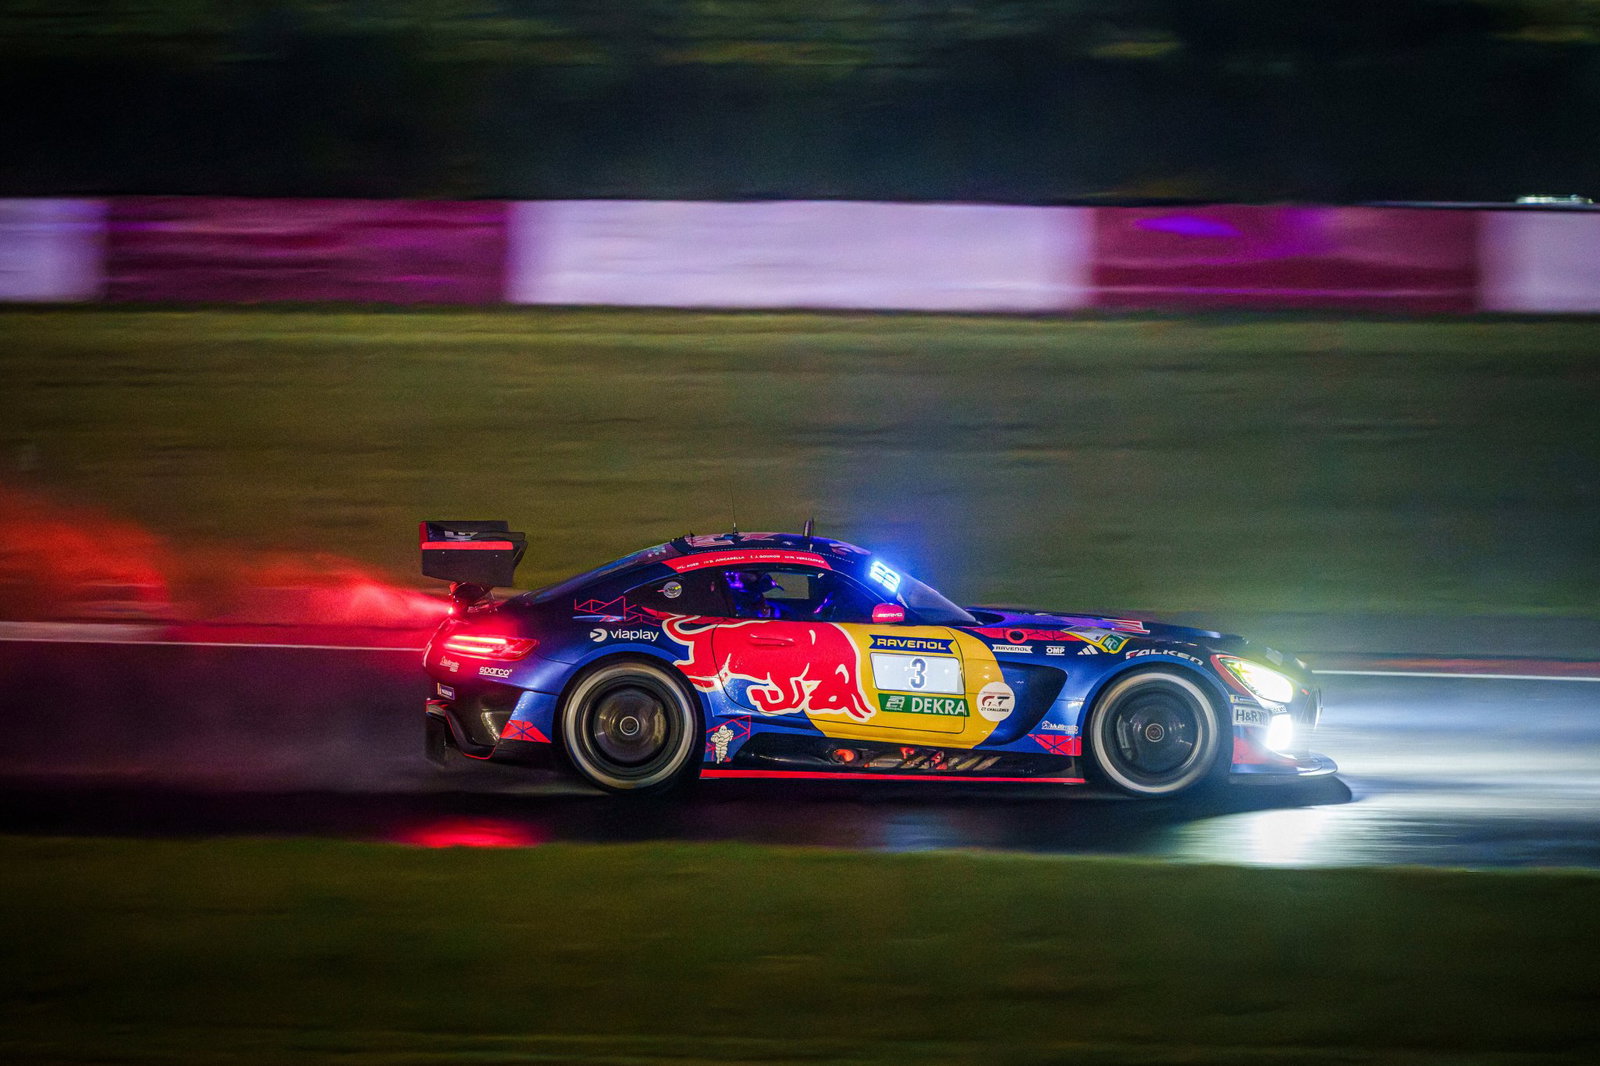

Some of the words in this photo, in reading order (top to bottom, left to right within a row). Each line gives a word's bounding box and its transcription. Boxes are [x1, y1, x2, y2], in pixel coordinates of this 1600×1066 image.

[610, 629, 660, 642] viaplay
[876, 638, 947, 651] RAVENOL
[1046, 647, 1066, 655] OMP
[1125, 648, 1204, 666] FALKEN
[479, 666, 511, 678] sparco
[910, 657, 927, 690] 3
[911, 697, 967, 716] DEKRA
[1236, 708, 1258, 722] H&R
